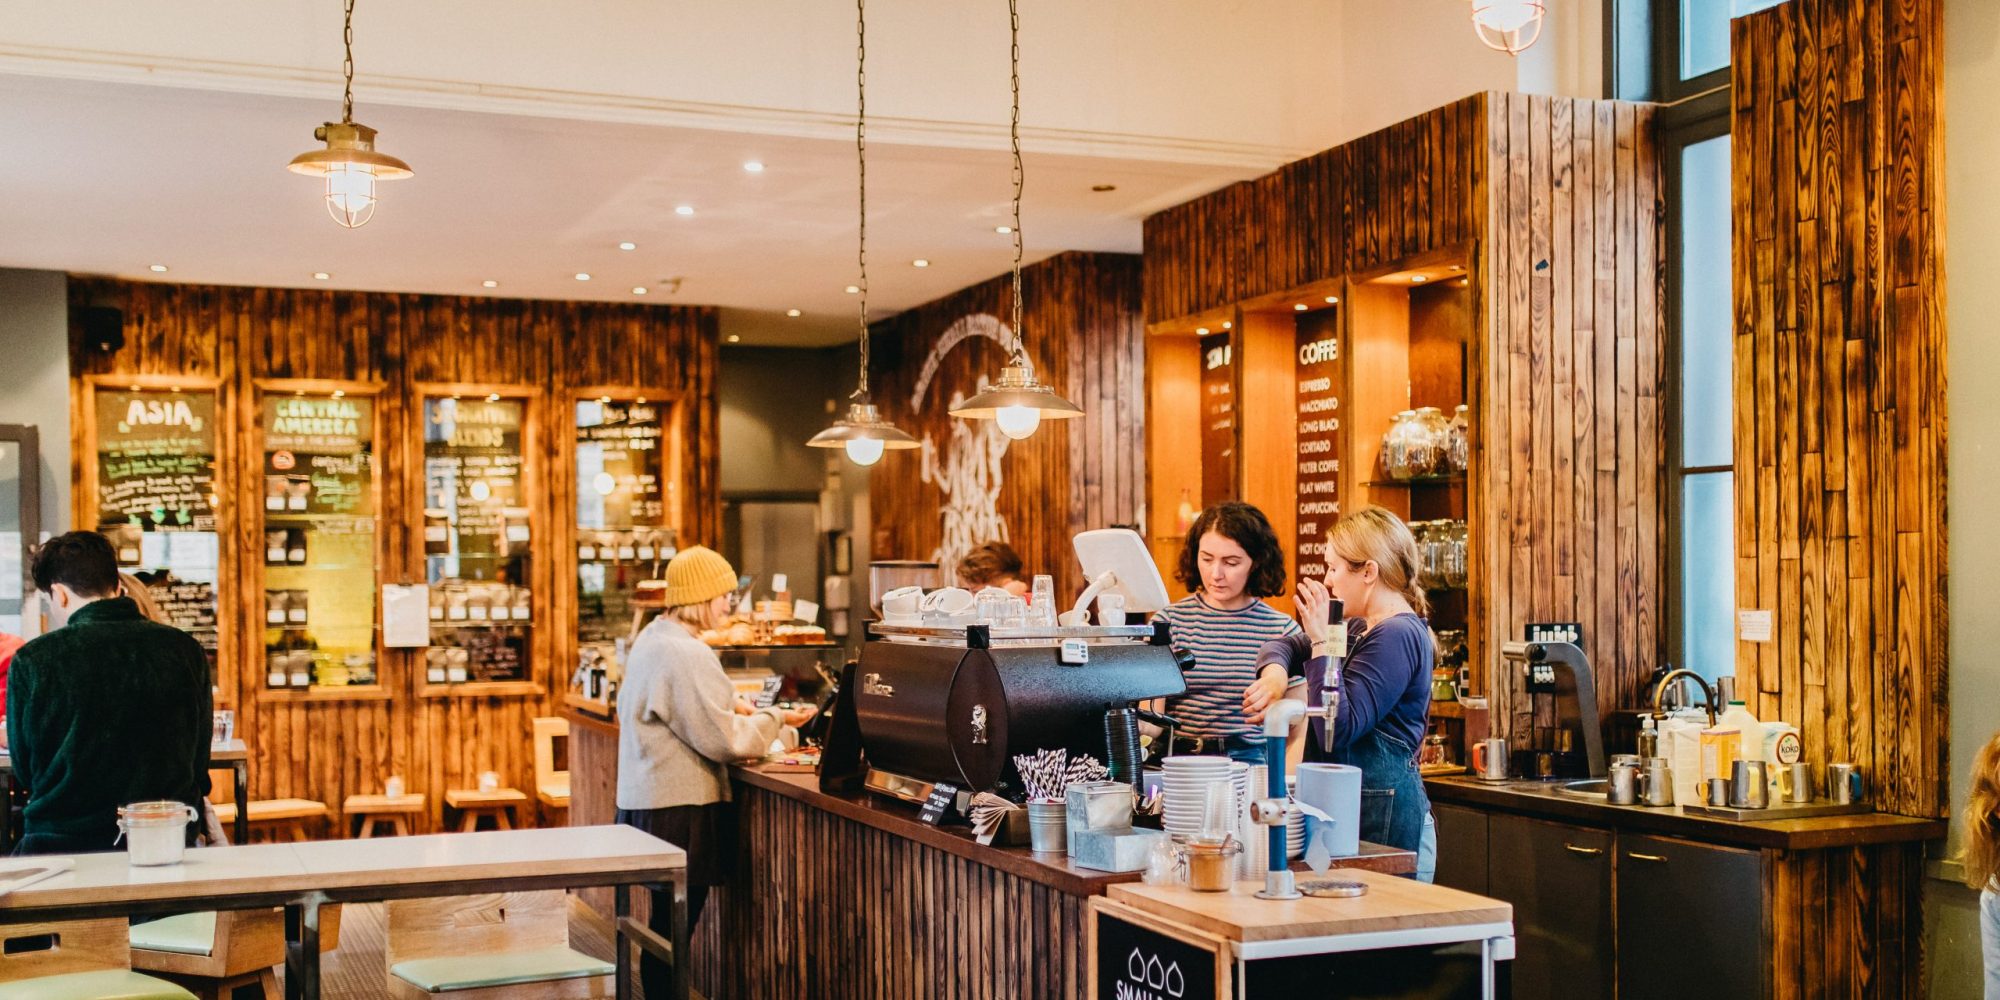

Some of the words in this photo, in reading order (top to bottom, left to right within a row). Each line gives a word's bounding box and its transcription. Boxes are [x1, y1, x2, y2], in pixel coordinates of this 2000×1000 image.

[1299, 338, 1338, 365] COFFE
[1299, 377, 1330, 393] ESPRESSO
[126, 399, 193, 425] ASIA
[276, 399, 361, 418] CENTRAL
[1299, 397, 1338, 413] MACCHIATO
[272, 417, 358, 435] AMERICA
[1299, 420, 1318, 434] LONG
[1299, 439, 1331, 454] CORTADO
[1299, 461, 1317, 474] FILTER
[1299, 482, 1313, 494] FLAT
[1314, 481, 1335, 493] WHITE
[1299, 522, 1317, 535] LATTE
[1299, 543, 1313, 555] HOT
[1299, 563, 1325, 575] MOCHA
[1781, 743, 1799, 753] koko
